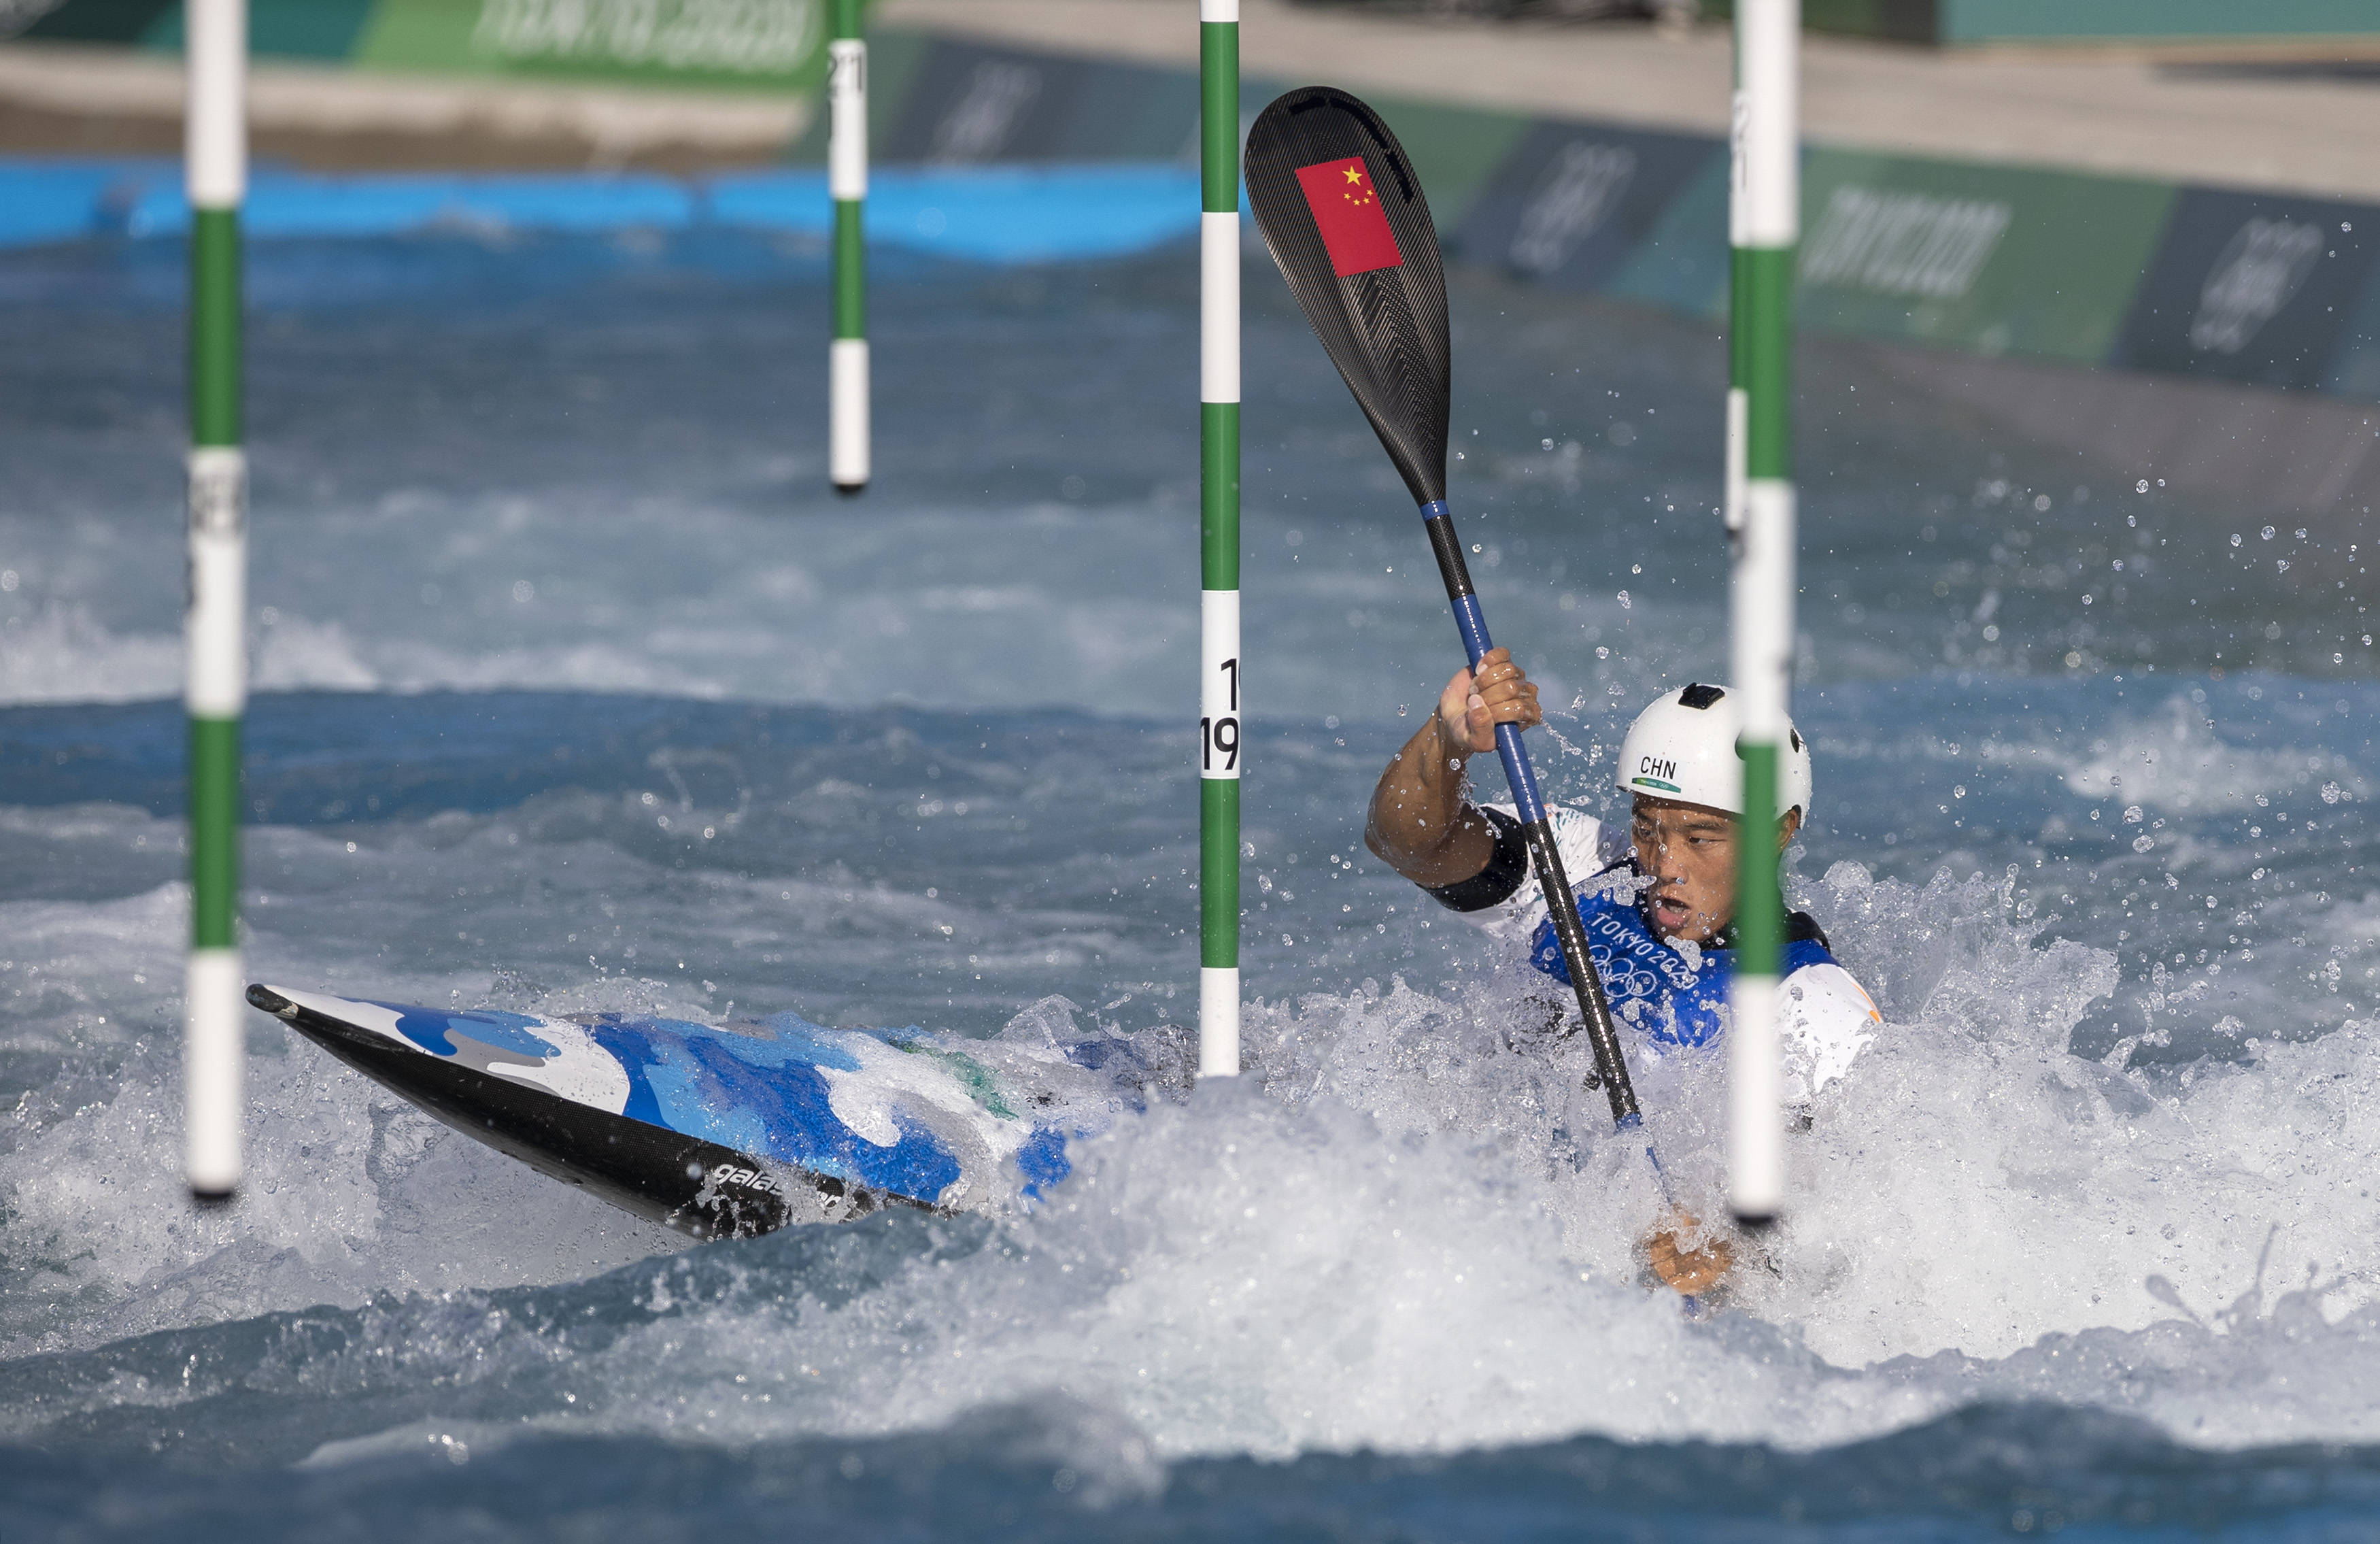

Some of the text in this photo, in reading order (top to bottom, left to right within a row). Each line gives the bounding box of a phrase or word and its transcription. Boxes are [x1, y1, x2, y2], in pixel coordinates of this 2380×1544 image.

[1221, 658, 1241, 711] 1
[1200, 717, 1240, 771] 19
[1640, 756, 1677, 780] CHN
[1591, 912, 1699, 990] TOKYO 2020
